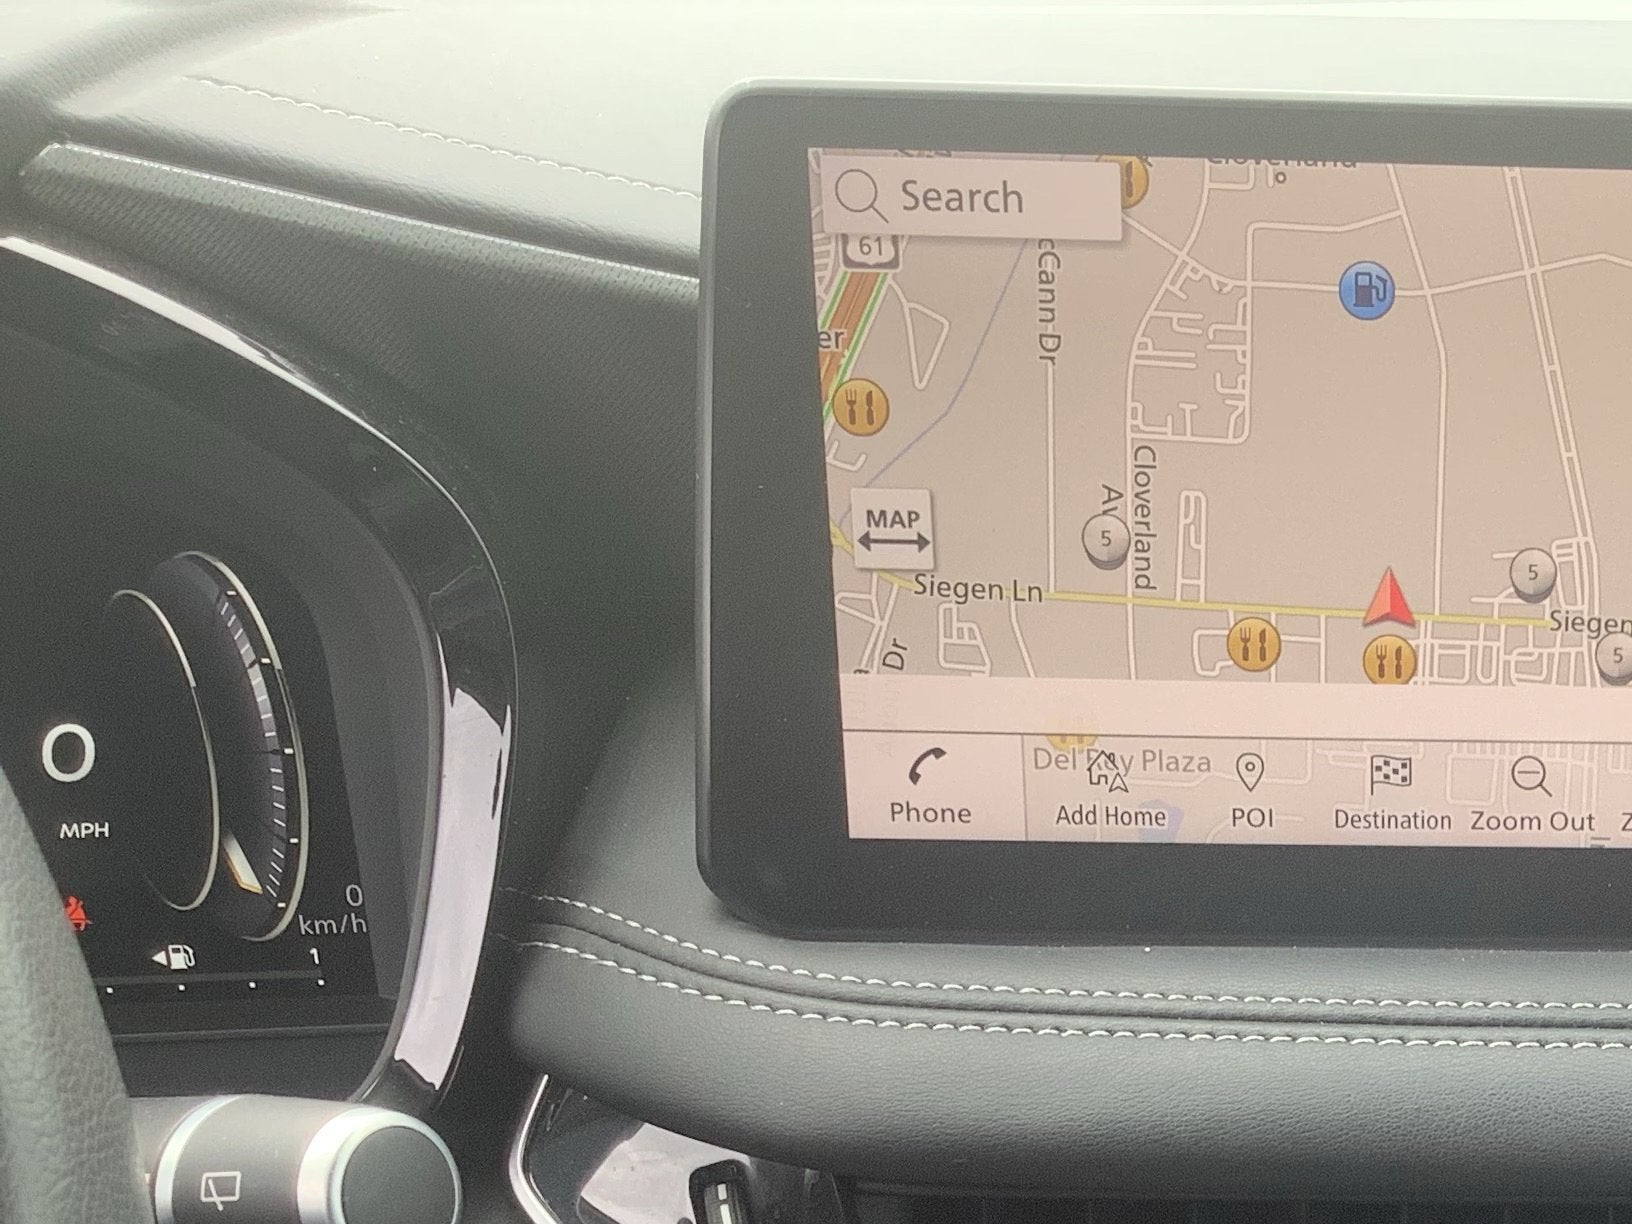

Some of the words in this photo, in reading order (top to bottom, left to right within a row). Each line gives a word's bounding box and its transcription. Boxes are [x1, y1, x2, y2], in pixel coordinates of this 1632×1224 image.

[900, 179, 1024, 214] Search
[858, 235, 884, 257] 61
[1038, 333, 1062, 366] Dr
[865, 509, 921, 530] MAP
[1134, 445, 1157, 590] Cloverland
[1101, 530, 1113, 547] 5
[1528, 563, 1539, 580] 5
[914, 573, 1004, 605] Siegen
[1013, 579, 1043, 603] Ln
[882, 637, 908, 671] Dr
[1613, 647, 1624, 664] 5
[1033, 747, 1078, 771] Del
[1142, 749, 1212, 773] Plaza
[890, 802, 972, 826] Phone
[1055, 804, 1097, 825] Add
[1105, 805, 1167, 827] Home
[1231, 808, 1274, 828] POI
[1334, 808, 1453, 830] Destination
[1470, 811, 1542, 831] Zoom
[1549, 811, 1597, 832] Out
[59, 822, 110, 840] MPH
[345, 883, 364, 907] 0
[298, 912, 367, 935] km/h
[309, 947, 320, 965] 1
